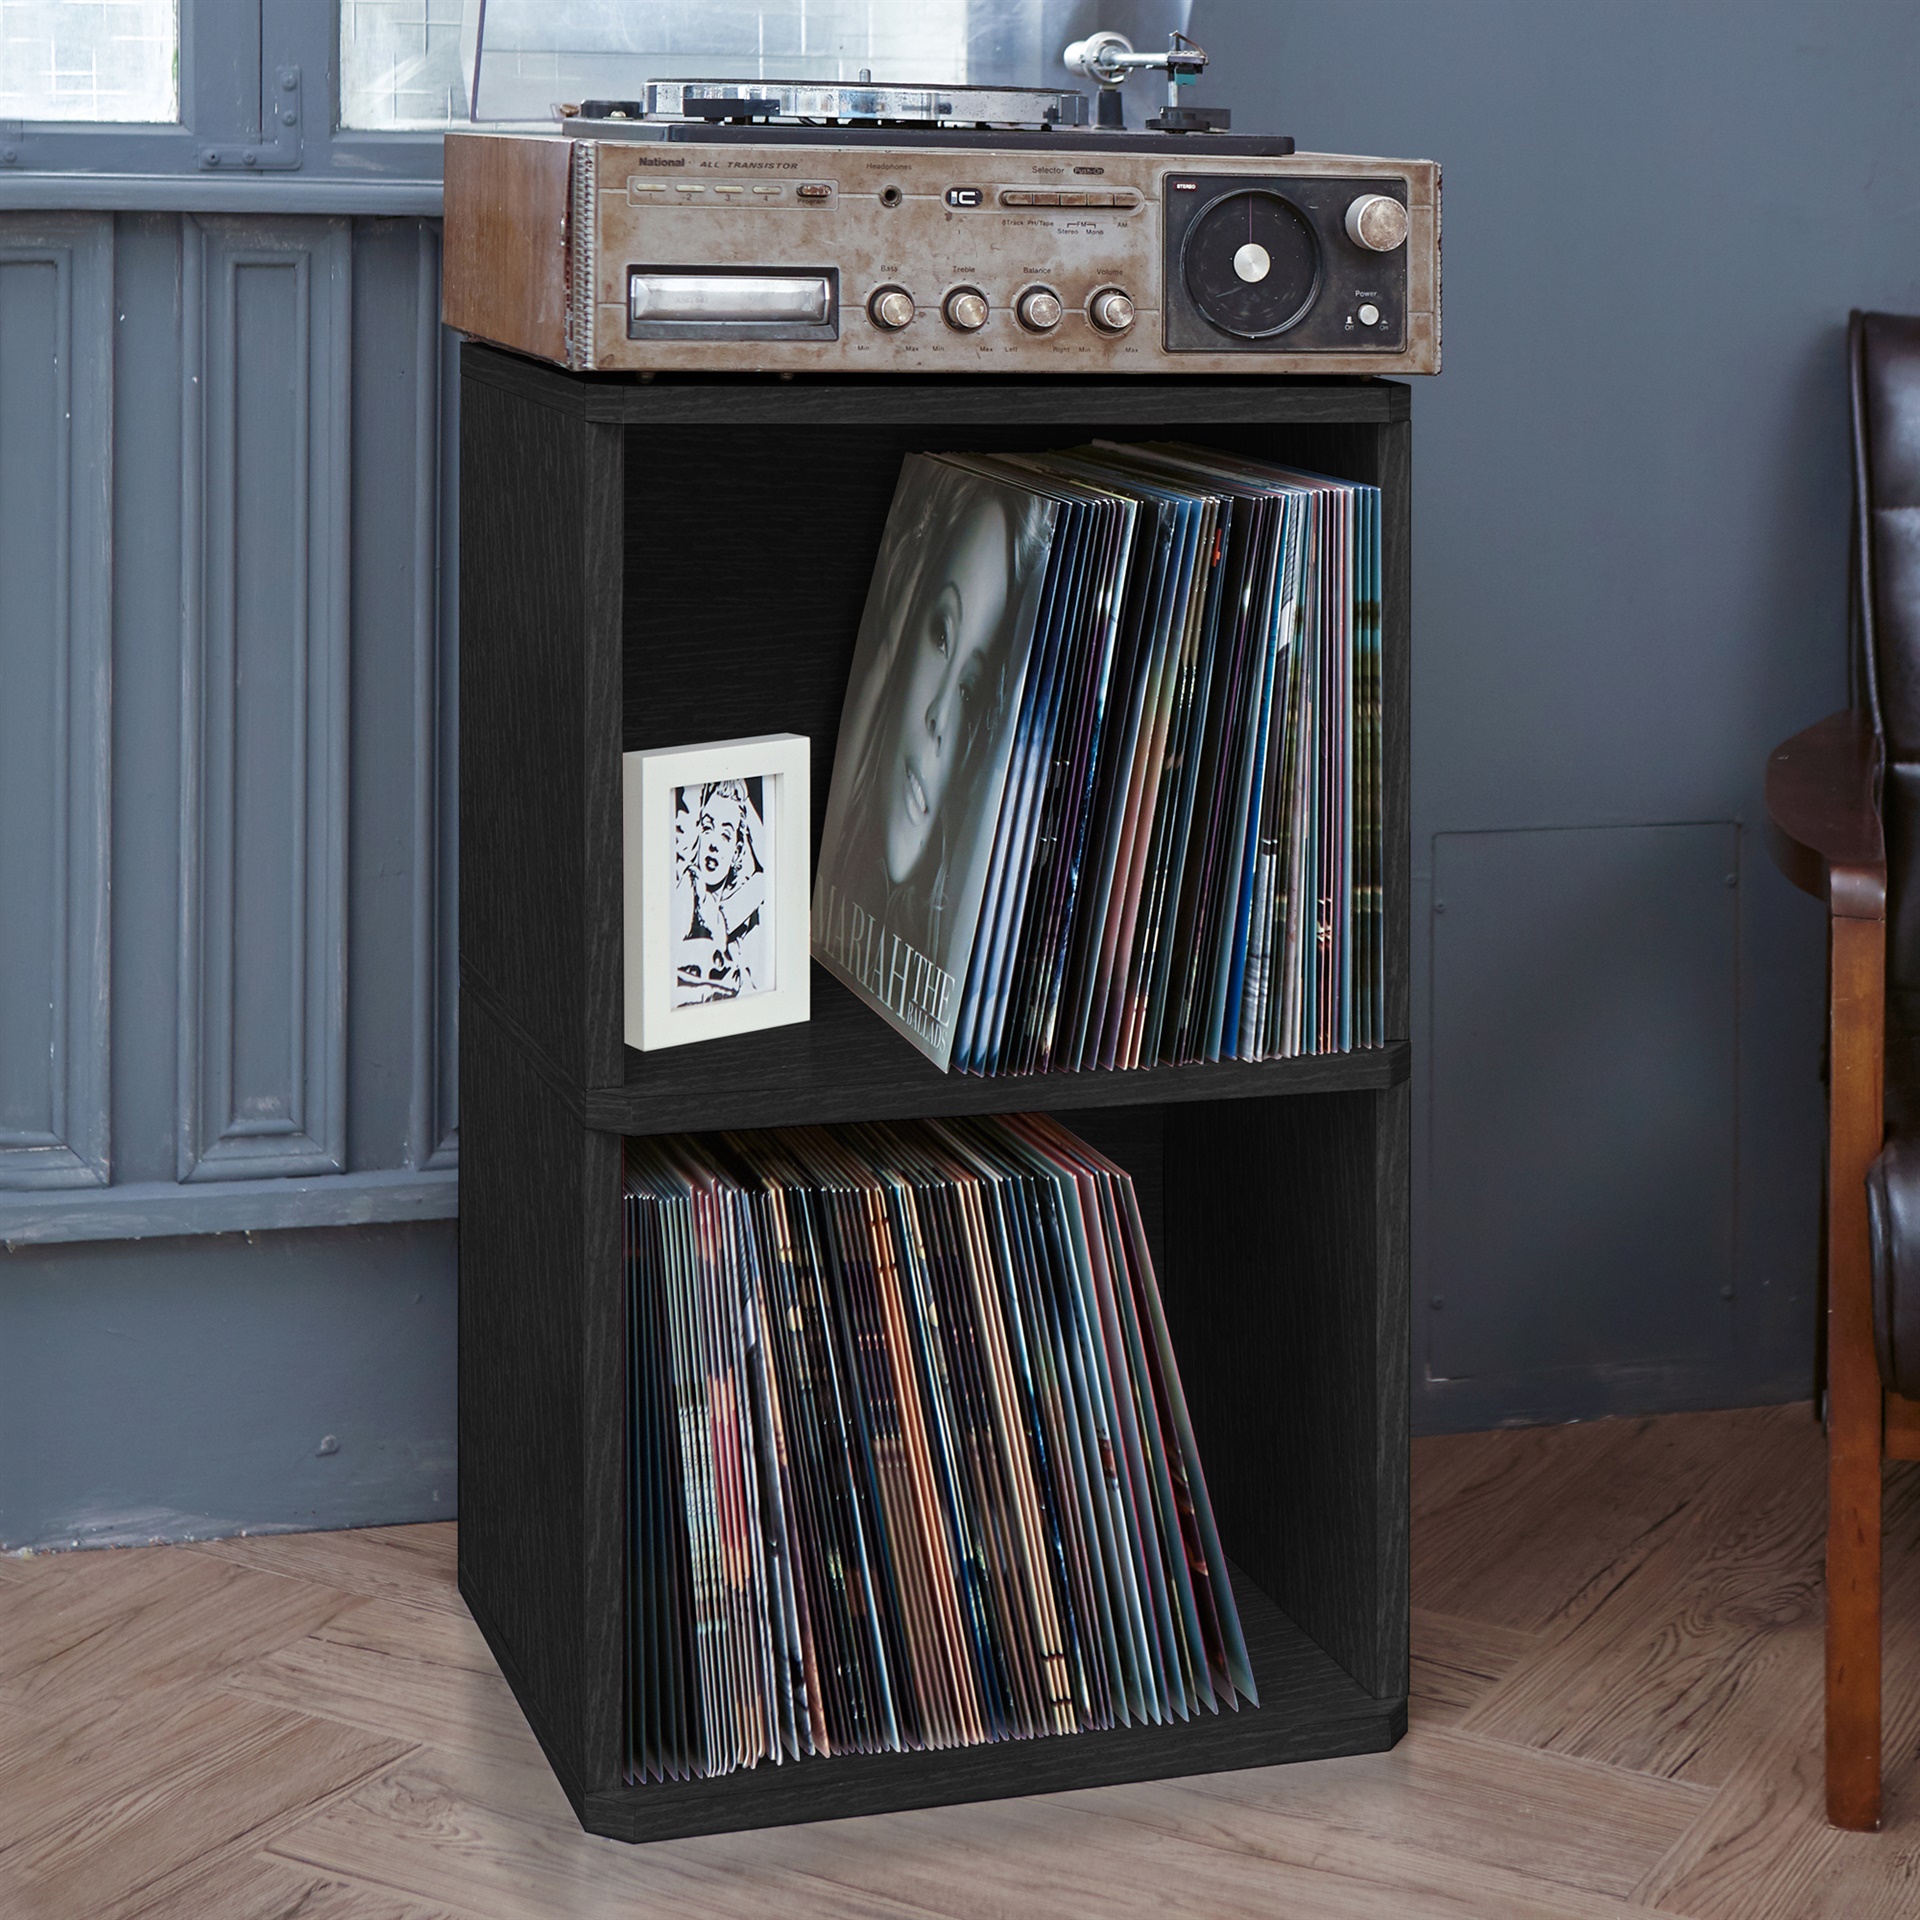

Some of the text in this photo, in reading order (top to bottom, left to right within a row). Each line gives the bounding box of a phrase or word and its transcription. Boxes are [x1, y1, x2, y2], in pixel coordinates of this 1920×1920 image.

[638, 157, 685, 168] National
[699, 161, 799, 170] ALL TRANSISTOR
[866, 163, 913, 171] Headphones
[1031, 165, 1065, 174] Selector
[686, 193, 693, 201] 2
[1057, 228, 1079, 236] Stereo
[880, 265, 899, 273] Bass
[952, 266, 976, 274] Treble
[1023, 267, 1052, 275] Balance
[1355, 290, 1377, 298] Power
[811, 873, 956, 1028] MARIAH THE
[906, 1001, 948, 1055] BALLADS
